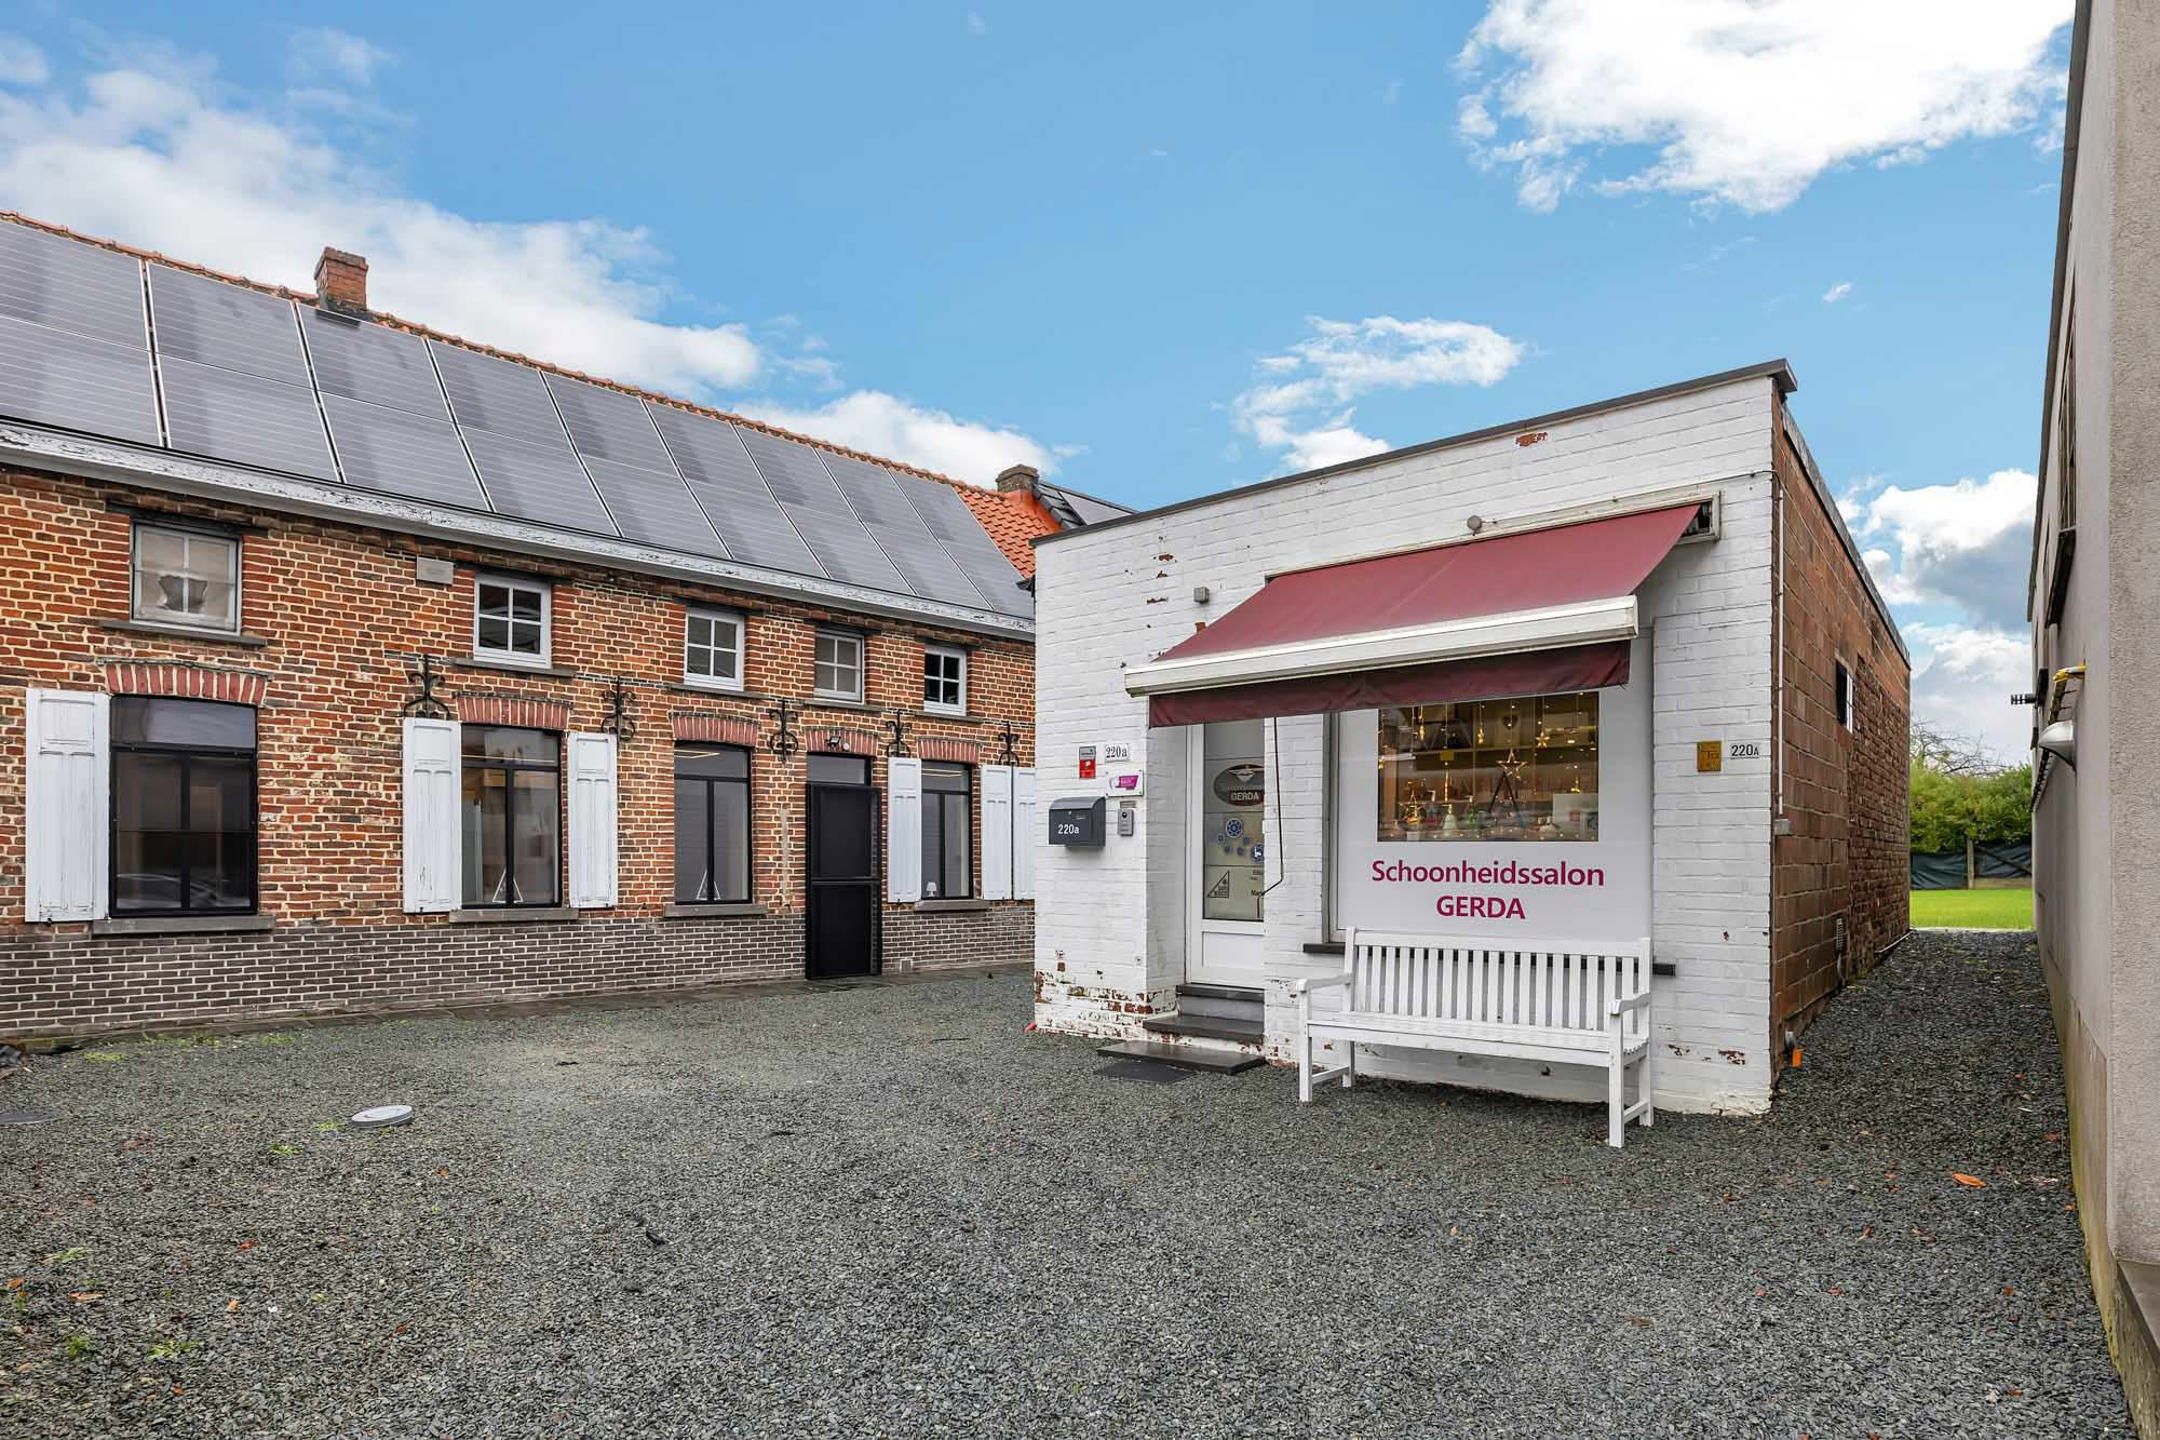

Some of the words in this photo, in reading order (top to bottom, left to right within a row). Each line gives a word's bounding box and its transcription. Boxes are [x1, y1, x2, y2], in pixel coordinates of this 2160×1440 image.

[1105, 746, 1128, 758] 220a
[1731, 744, 1759, 756] 220A
[1231, 791, 1259, 800] GERDA
[1057, 824, 1080, 834] 220a
[1372, 859, 1604, 886] Schoonheidssalon
[1436, 895, 1526, 919] GERDA
